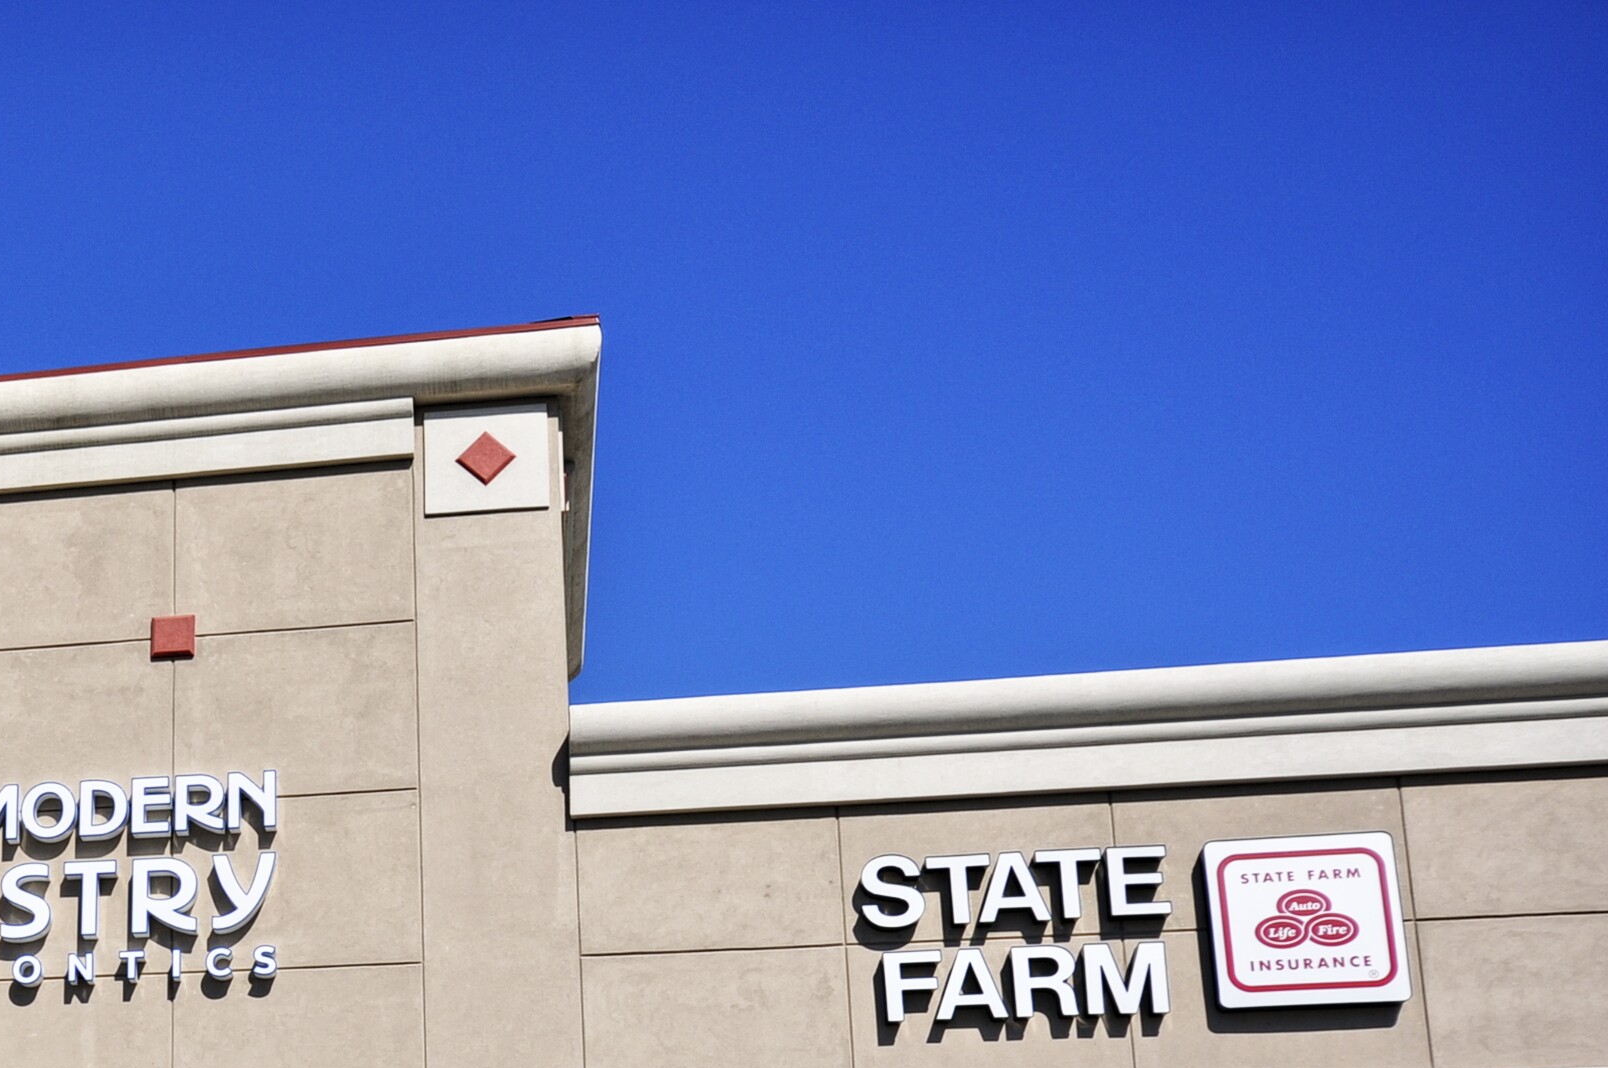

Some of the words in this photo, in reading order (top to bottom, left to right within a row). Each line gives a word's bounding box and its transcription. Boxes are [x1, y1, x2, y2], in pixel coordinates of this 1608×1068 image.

[1241, 871, 1294, 884] STATE
[1307, 868, 1361, 880] FARM
[860, 845, 1172, 928] STATE
[1289, 901, 1321, 911] Auto
[1268, 926, 1296, 940] Life
[1318, 925, 1348, 935] Fire
[1250, 955, 1372, 972] INSURANCE
[882, 941, 1171, 1023] FARM
